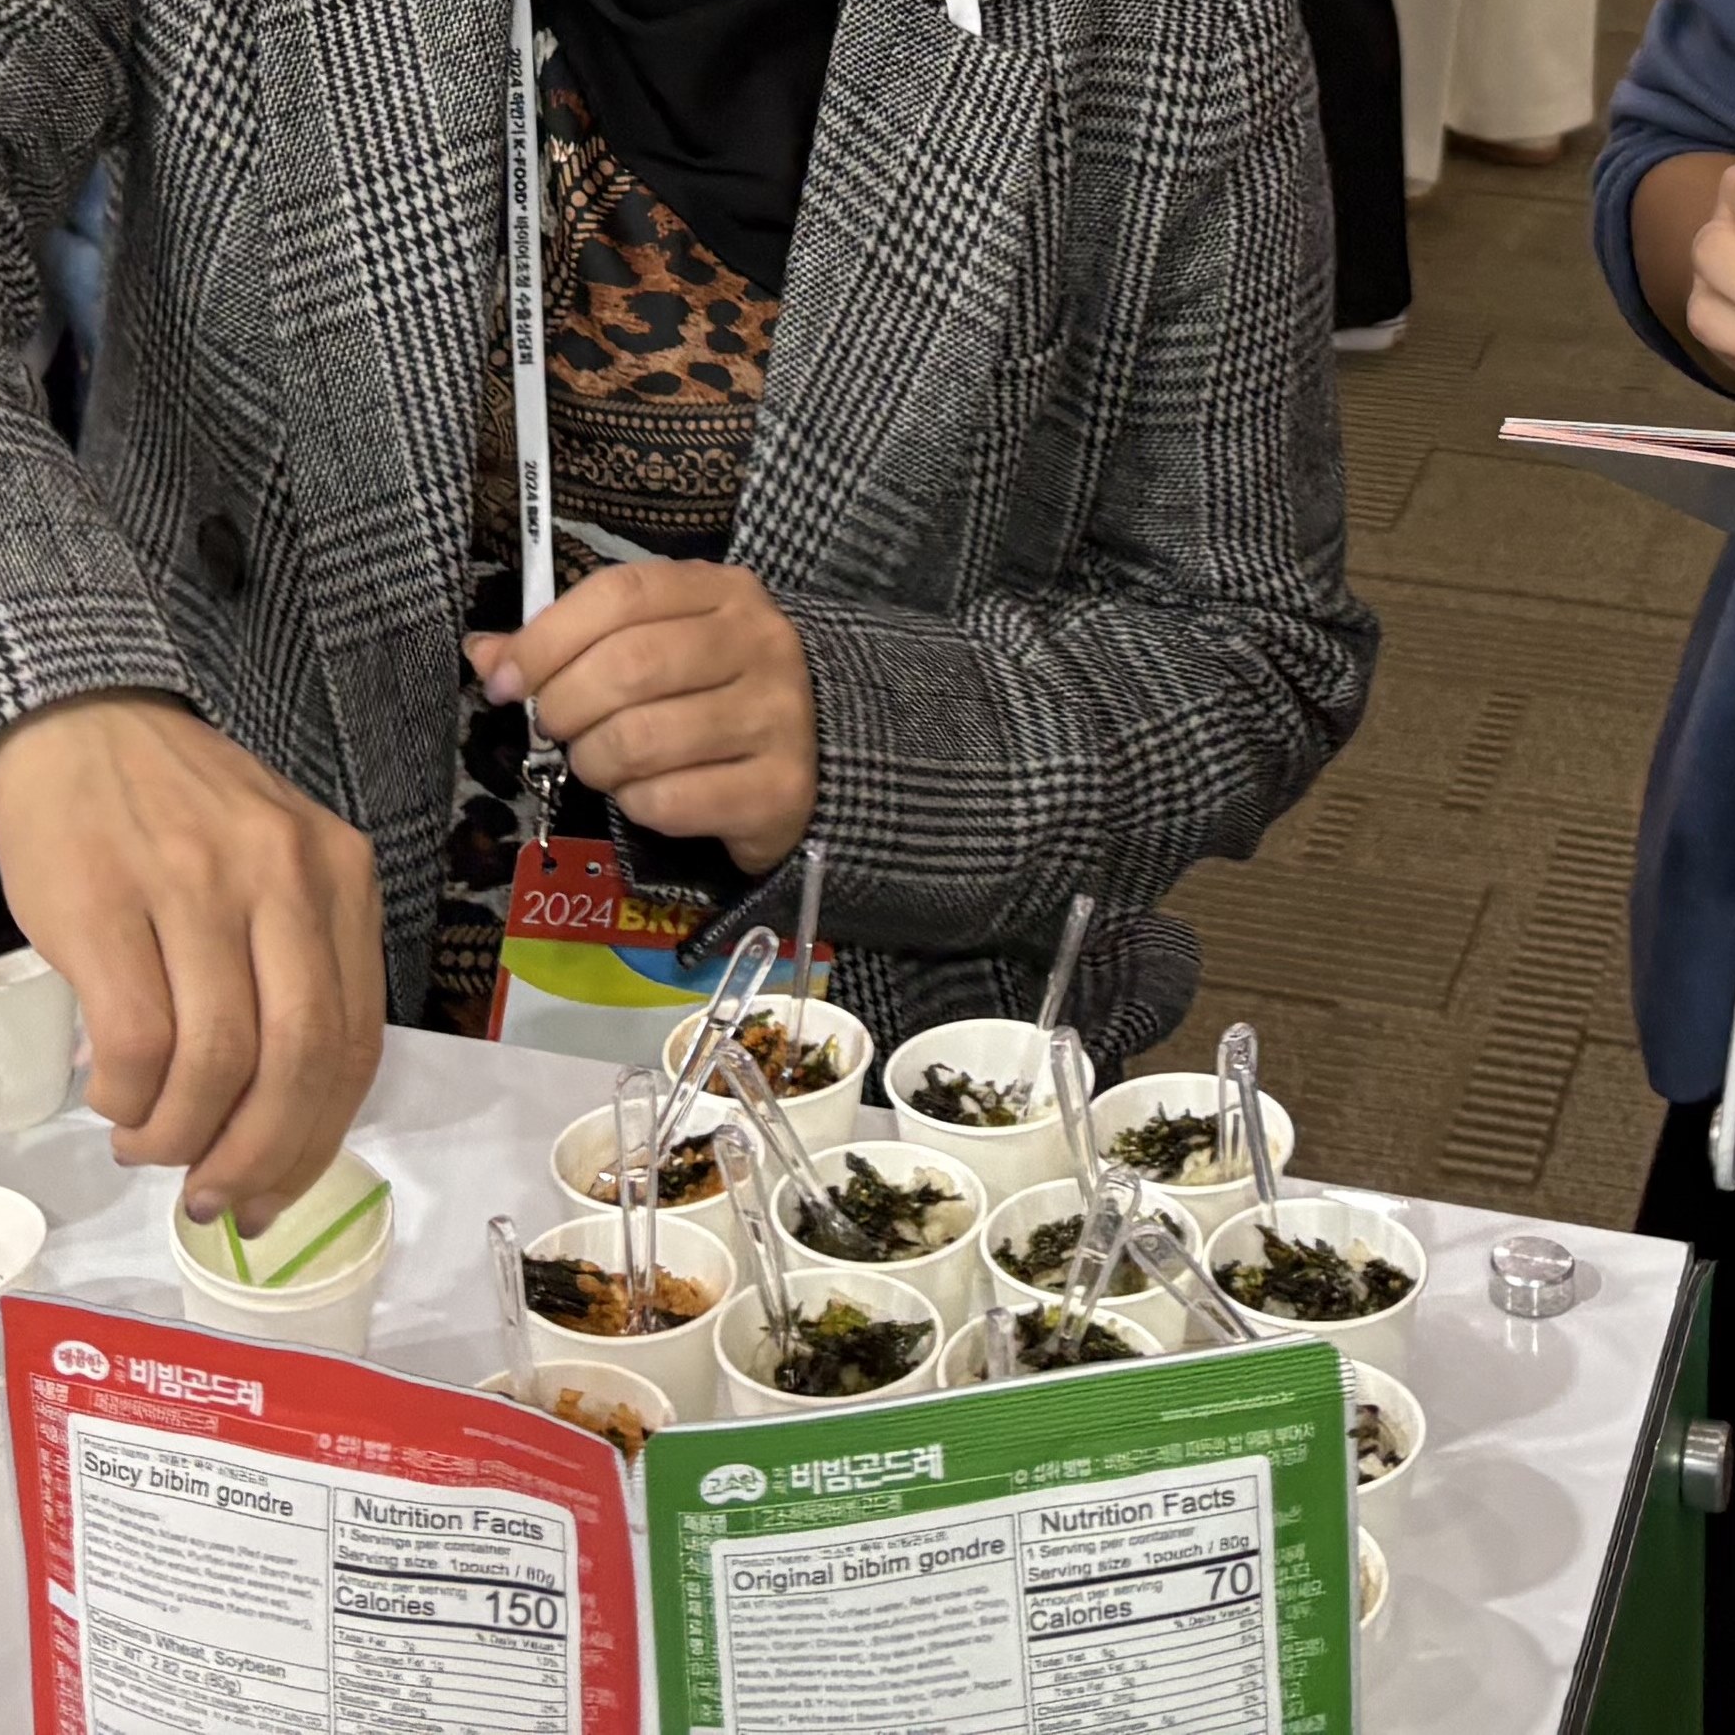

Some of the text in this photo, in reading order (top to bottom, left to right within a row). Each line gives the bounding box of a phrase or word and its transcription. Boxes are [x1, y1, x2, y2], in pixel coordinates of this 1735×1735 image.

[514, 215, 531, 289] 바이어초청
[515, 291, 534, 365] 수출상담회
[522, 889, 614, 929] 2024
[128, 1357, 264, 1417] 비빔곤드레
[83, 1451, 293, 1517] Spicy bibim gondre
[790, 1443, 945, 1495] 비빔곤드레
[354, 1496, 545, 1542] Nutrition Facts
[1039, 1486, 1237, 1535] Nutrition Facts
[338, 1544, 399, 1570] Serving
[404, 1555, 438, 1569] size
[350, 1528, 413, 1550] Servings
[416, 1539, 440, 1554] per
[1028, 1561, 1093, 1583] Serving
[1098, 1556, 1132, 1572] size
[1142, 1543, 1204, 1565] 1pouch
[1040, 1539, 1097, 1560] Serving
[1100, 1535, 1126, 1552] per
[732, 1536, 1006, 1593] Original bibim gondre
[336, 1585, 558, 1630] Calories 150
[1030, 1578, 1164, 1610] Amount per serving
[1030, 1561, 1254, 1634] Calories 70
[214, 1650, 287, 1679] Soybean
